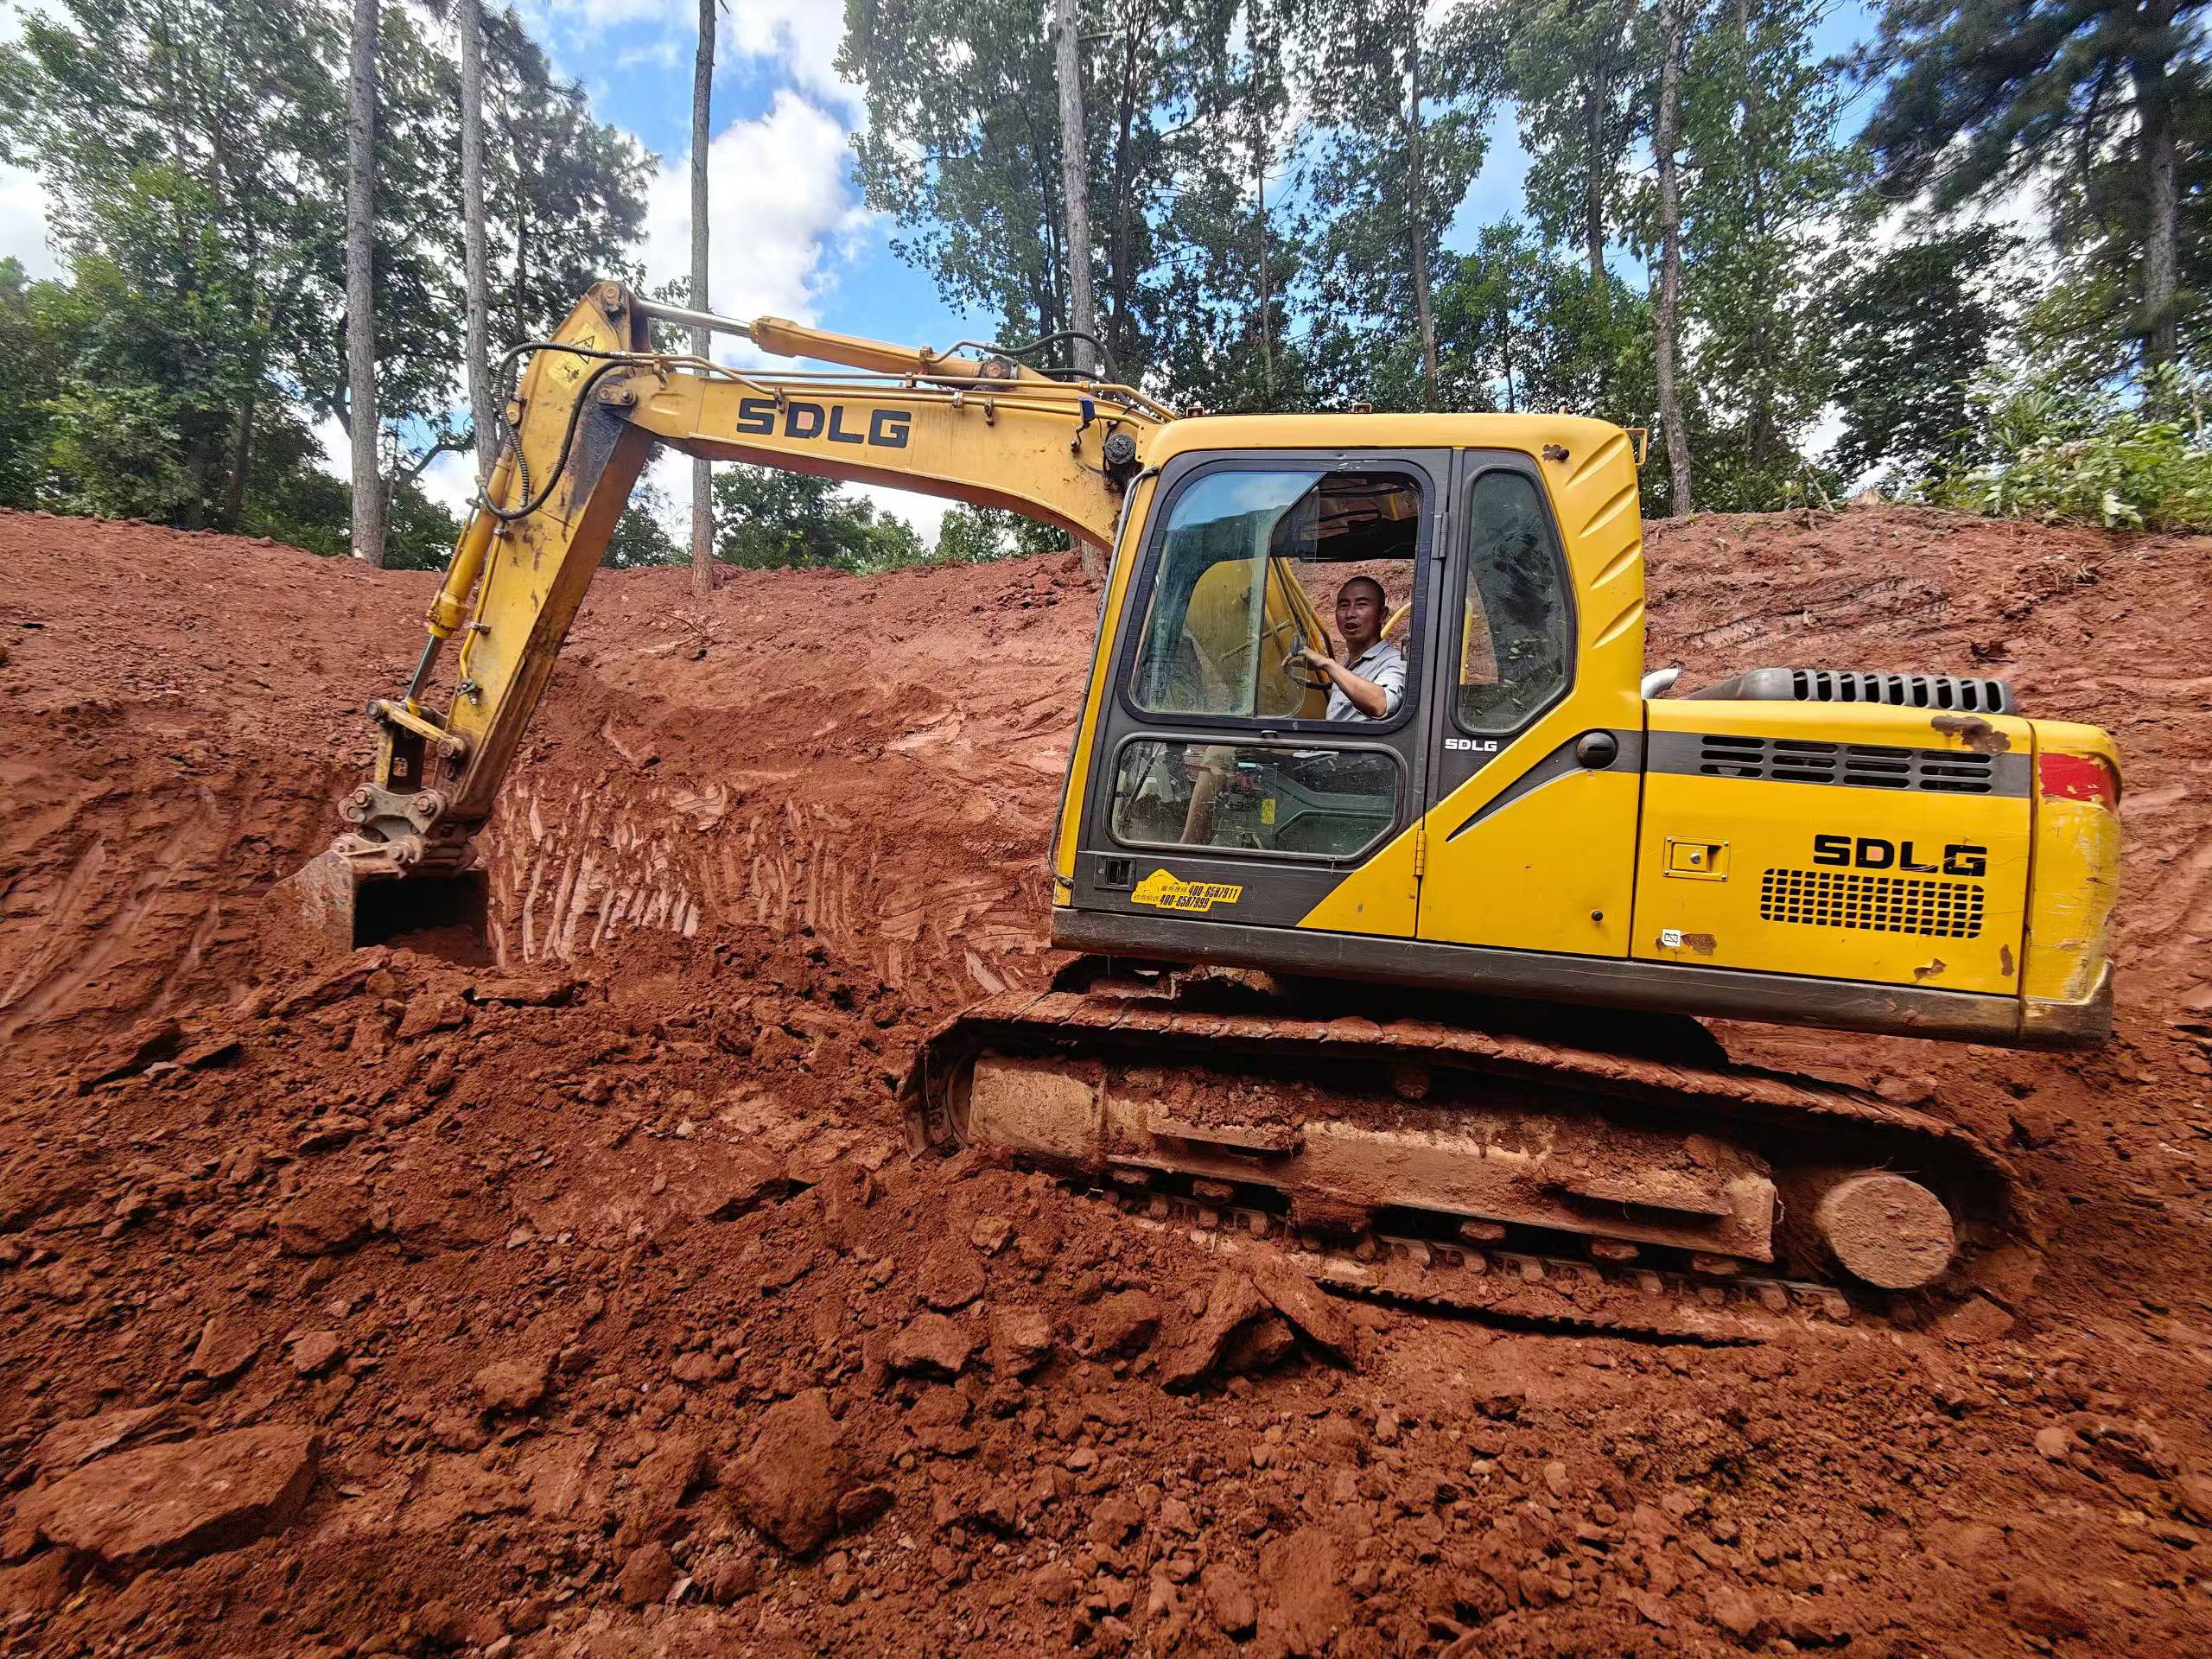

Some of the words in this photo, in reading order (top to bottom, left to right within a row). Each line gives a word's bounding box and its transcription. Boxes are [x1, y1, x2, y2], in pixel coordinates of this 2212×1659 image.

[736, 397, 912, 448] SDLG
[1445, 738, 1497, 752] SDLG
[1814, 834, 1987, 877] SDLG
